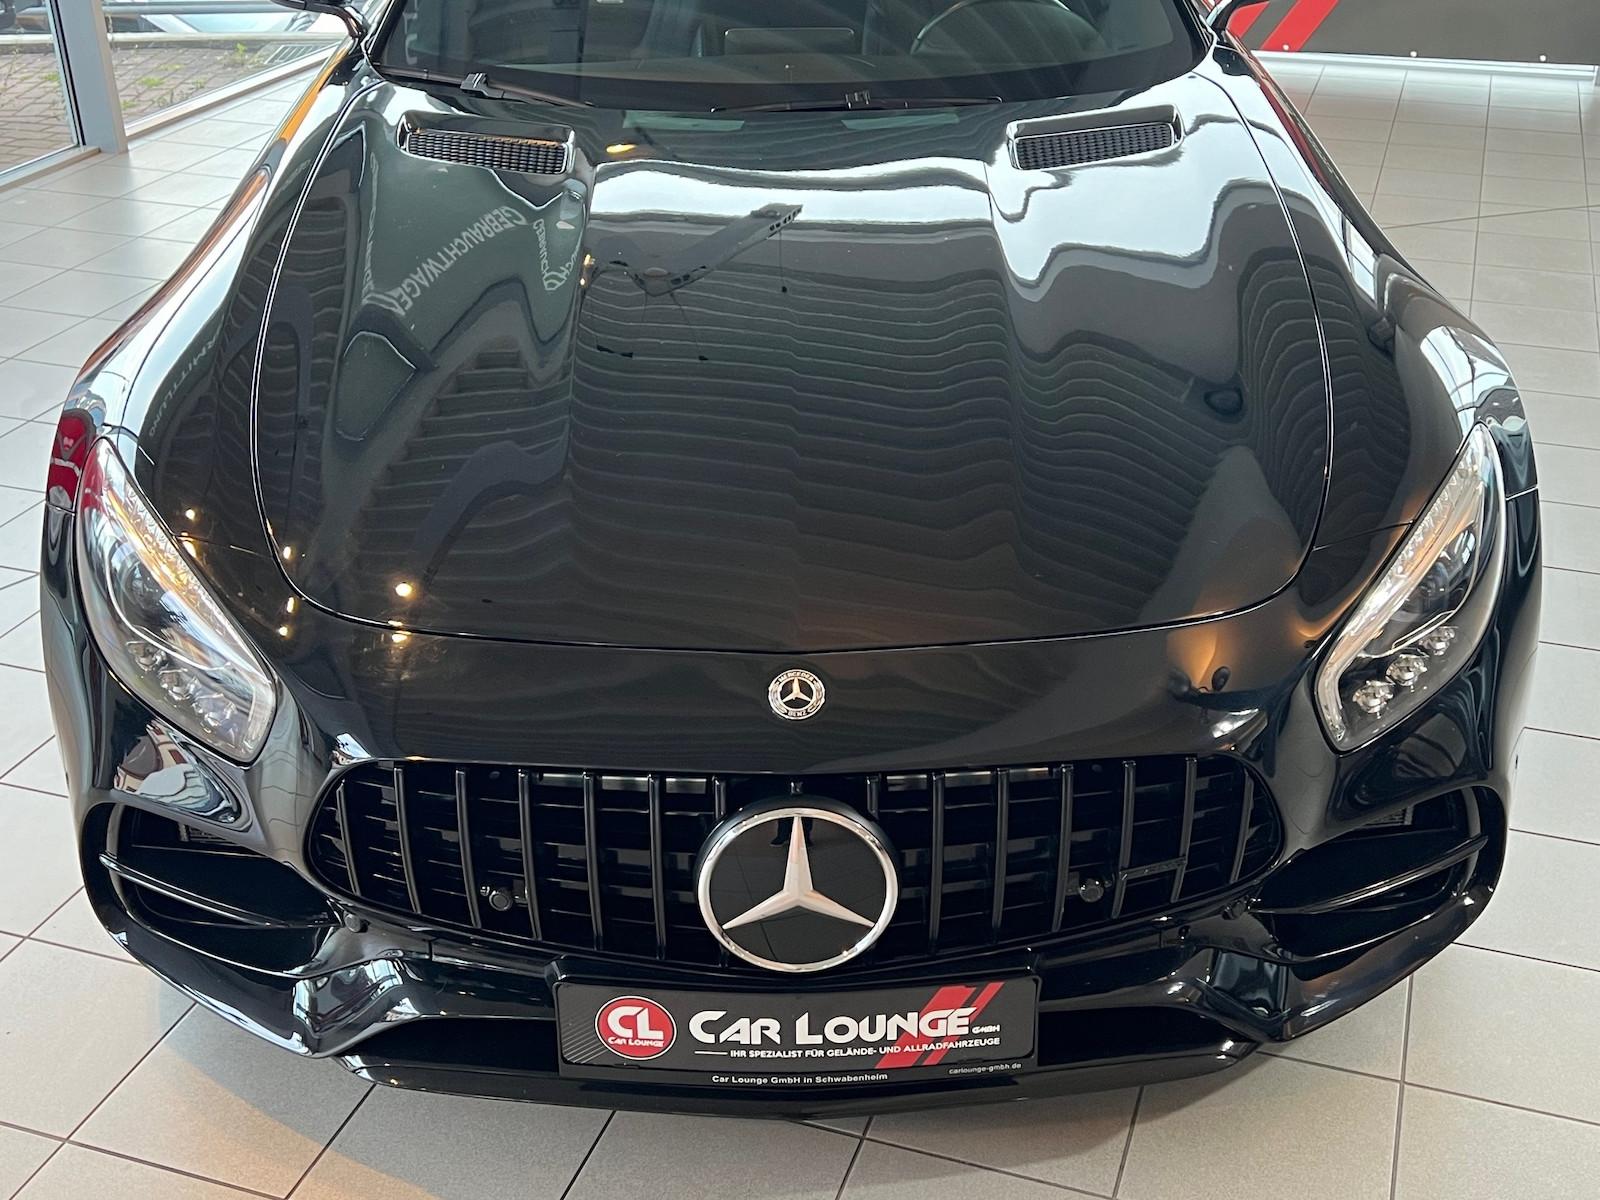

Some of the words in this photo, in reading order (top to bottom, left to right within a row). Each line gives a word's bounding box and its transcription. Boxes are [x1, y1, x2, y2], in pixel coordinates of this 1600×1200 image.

[607, 1006, 664, 1039] CL
[689, 1010, 781, 1045] CAR
[795, 1006, 977, 1045] LOUNGE
[607, 1036, 627, 1045] CAR
[628, 1039, 664, 1048] LOUNGE
[730, 1049, 747, 1057] IHR
[749, 1049, 802, 1058] SPEZIALIST
[805, 1048, 825, 1058] FÜR
[827, 1047, 877, 1057] GELÄNDE-
[878, 1045, 901, 1054] UND
[903, 1037, 1000, 1052] ALLRADFAHRZEUGE
[712, 1075, 729, 1083] Car
[732, 1076, 768, 1085] Lounge
[804, 1075, 813, 1084] in
[815, 1073, 888, 1084] Schwabenheim
